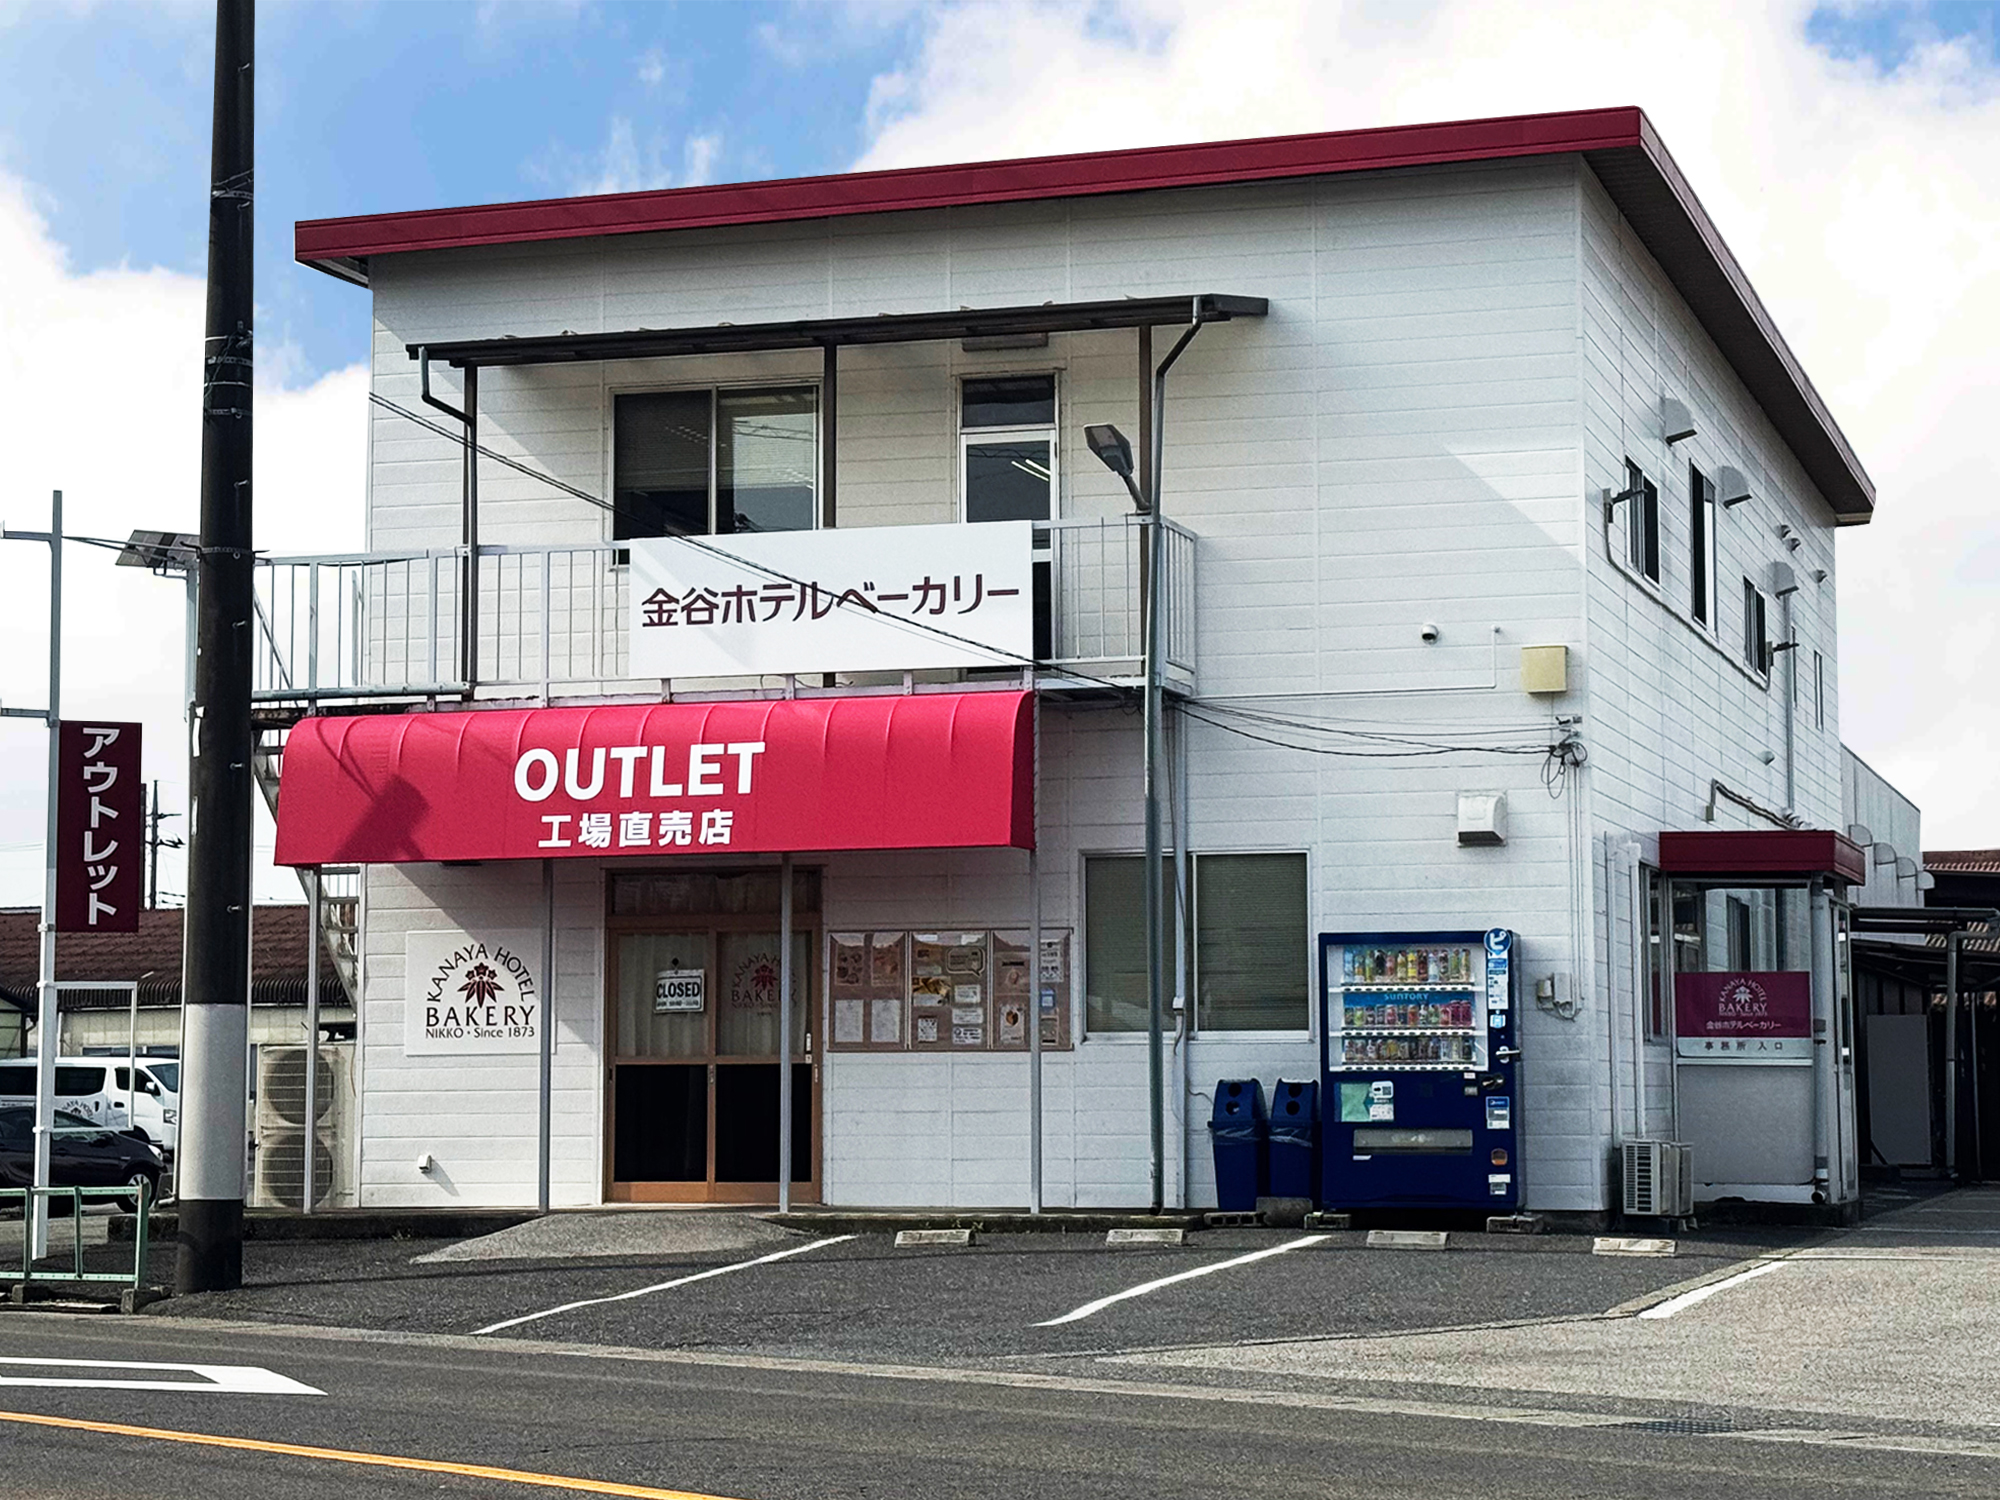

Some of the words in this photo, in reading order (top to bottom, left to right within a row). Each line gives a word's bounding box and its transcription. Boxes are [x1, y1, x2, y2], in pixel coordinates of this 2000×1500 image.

[641, 573, 1020, 628] 金谷ホテルベーカリー
[513, 741, 766, 802] OUTLET
[82, 727, 121, 925] アウトレット
[537, 808, 734, 849] 工場直売店
[426, 943, 489, 1003] KANAYA
[493, 946, 535, 1002] HOTEL
[656, 981, 700, 999] CLOSED
[426, 1005, 535, 1027] BAKERY
[1718, 1002, 1768, 1013] BAKERY
[426, 1028, 464, 1039] NIKKO
[474, 1027, 504, 1038] Since
[508, 1026, 535, 1037] 1873
